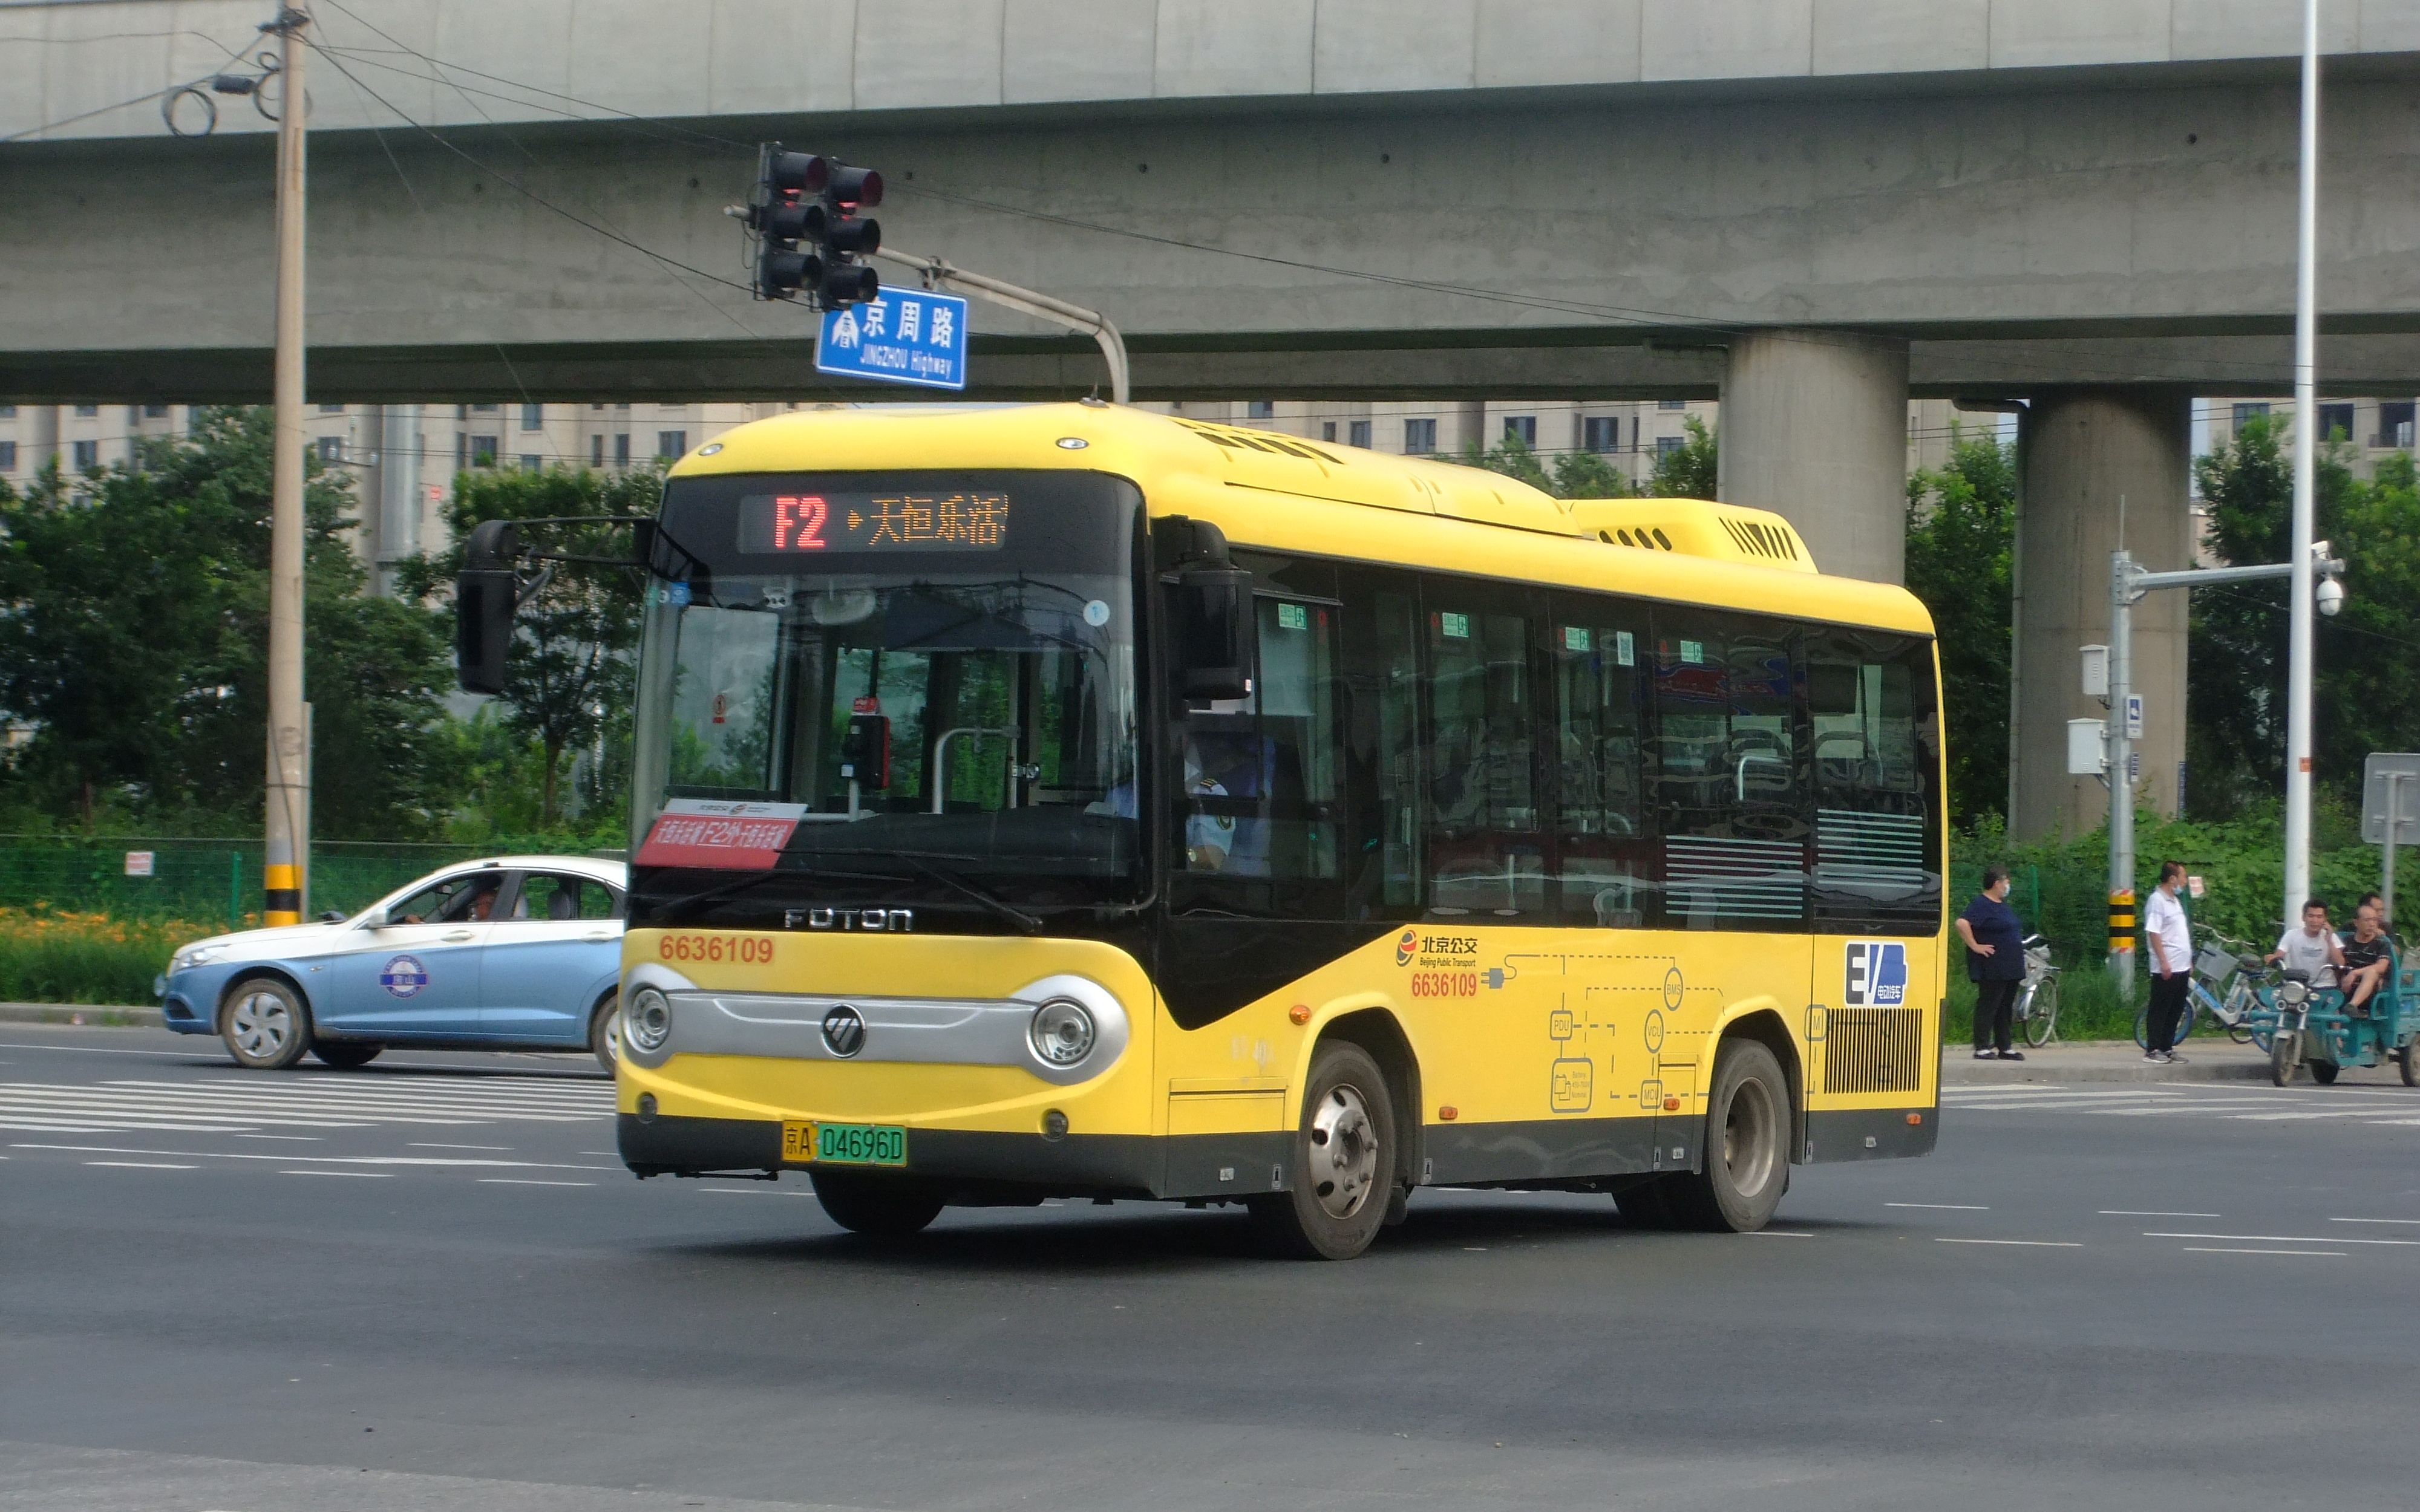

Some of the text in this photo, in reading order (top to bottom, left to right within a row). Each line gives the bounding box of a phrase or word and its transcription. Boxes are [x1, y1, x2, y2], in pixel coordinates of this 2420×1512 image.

[862, 296, 954, 348] 京周路
[860, 344, 952, 380] JINGZHOU Highway
[775, 497, 826, 548] F2
[869, 494, 1009, 546] 天恒乐活
[784, 908, 912, 931] FOTON
[659, 935, 773, 963] 6636109
[1421, 936, 1478, 954] 北京公交
[1419, 957, 1476, 969] Beijing Public Transport
[1412, 973, 1477, 997] 6636109
[1666, 984, 1681, 996] BMS
[1877, 985, 1901, 999] 电动汽车
[1554, 1020, 1569, 1031] PDU
[1647, 1026, 1662, 1037] VCU
[1644, 1089, 1658, 1100] MCU
[786, 1127, 902, 1159] 京A 04696D
